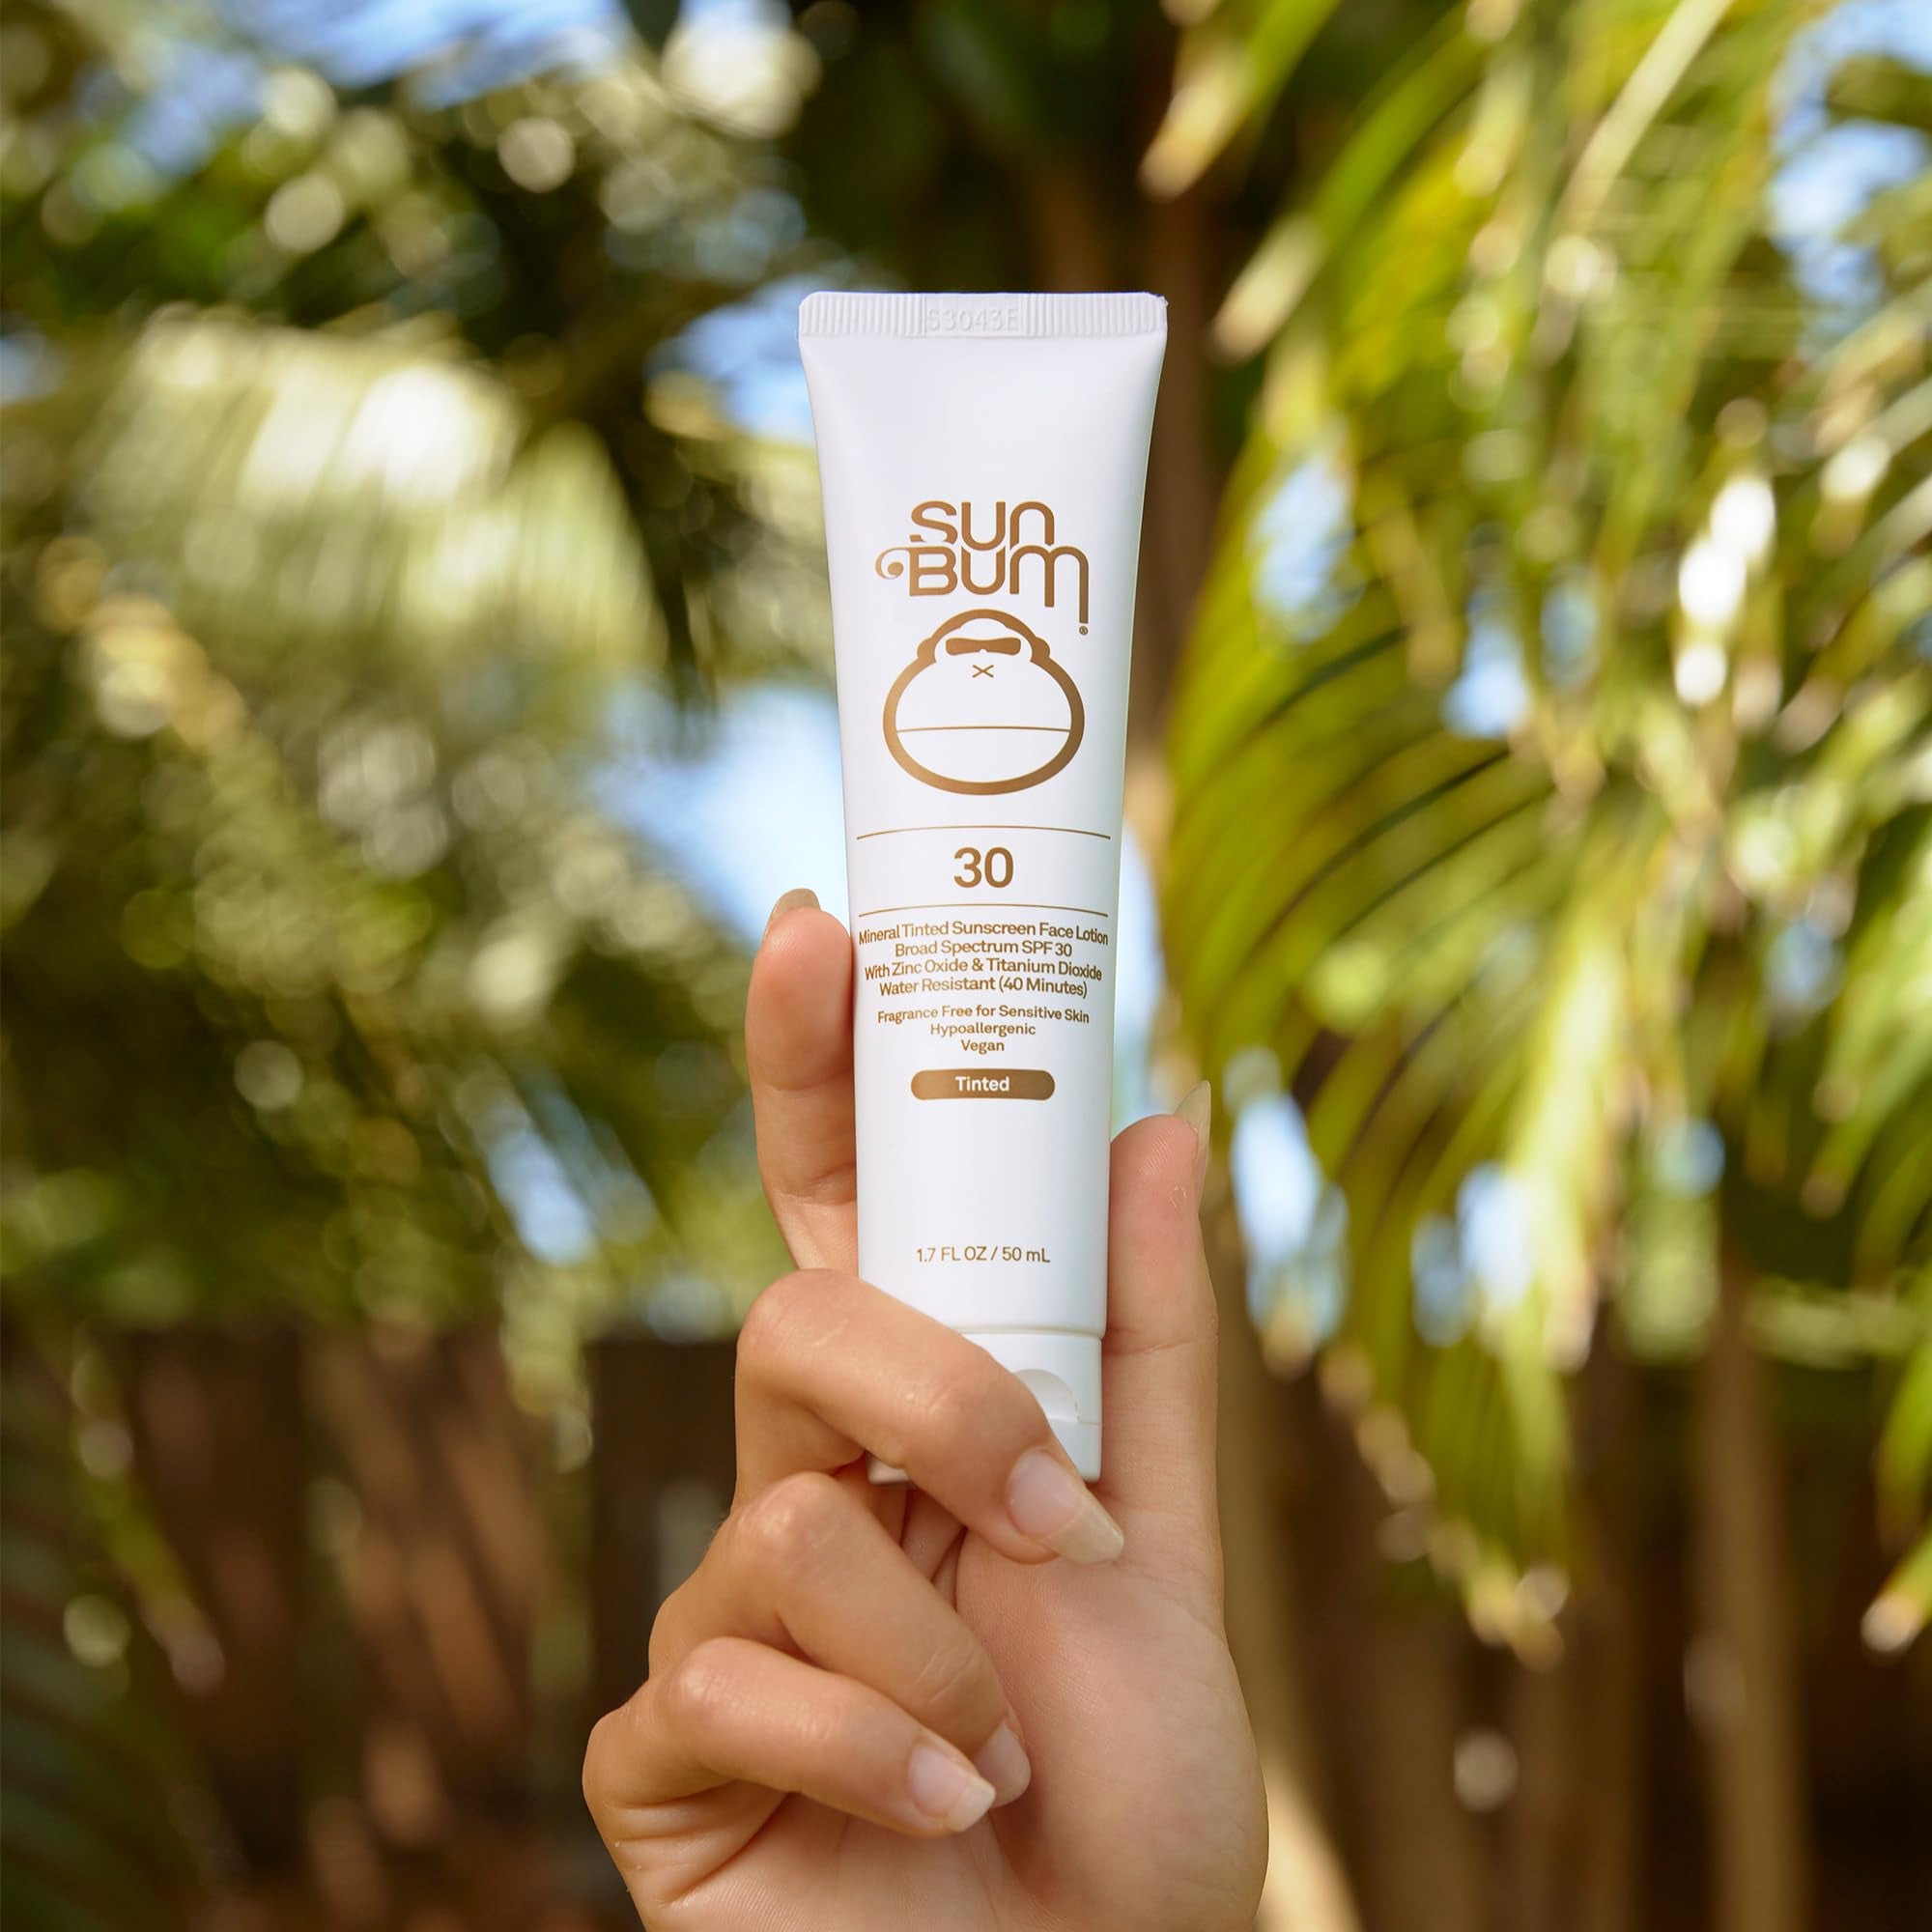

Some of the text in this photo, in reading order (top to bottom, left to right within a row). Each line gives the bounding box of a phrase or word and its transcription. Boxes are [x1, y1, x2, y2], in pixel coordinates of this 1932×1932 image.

[953, 846, 1014, 889] 30
[858, 920, 1109, 947] Mineral Tinted Sunscreen Face Lotion
[895, 939, 1073, 958] Broad Spectrum SPF 30
[864, 957, 1102, 981] With Zinc Oxide & Titanium Dioxide
[879, 975, 1088, 999] Water Resistant (40 Minutes)
[877, 1004, 1090, 1025] Fragrance Free for Sensitive Skin
[930, 1021, 1037, 1038] Hypoallergenic
[960, 1038, 1006, 1056] Vegan
[954, 1075, 1010, 1092] Tinted
[916, 1245, 1051, 1264] 1.7 FL OZ / 50 mL
